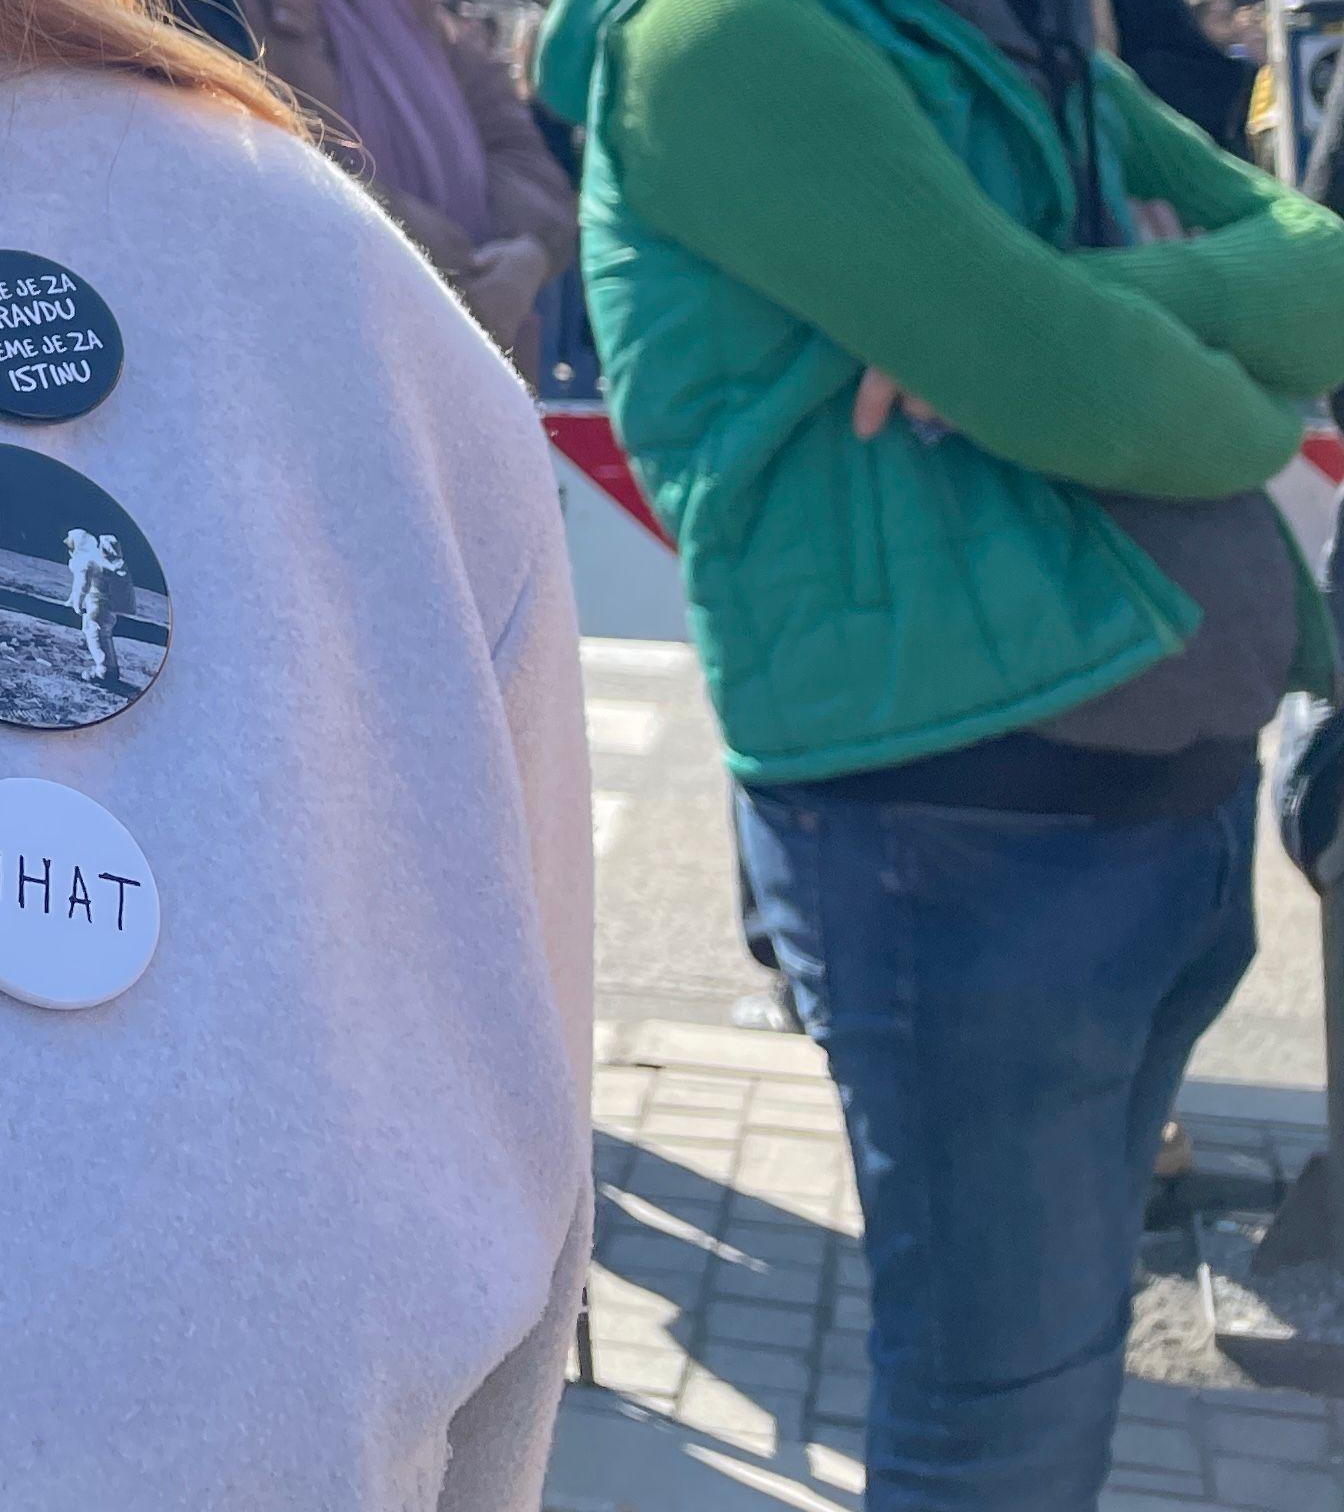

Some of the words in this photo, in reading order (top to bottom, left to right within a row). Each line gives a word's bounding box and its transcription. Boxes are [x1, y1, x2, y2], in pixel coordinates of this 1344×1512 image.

[16, 276, 42, 298] JE
[44, 272, 77, 295] ZA
[41, 334, 67, 355] JE
[69, 328, 104, 352] ZA
[7, 358, 93, 394] ISTINU
